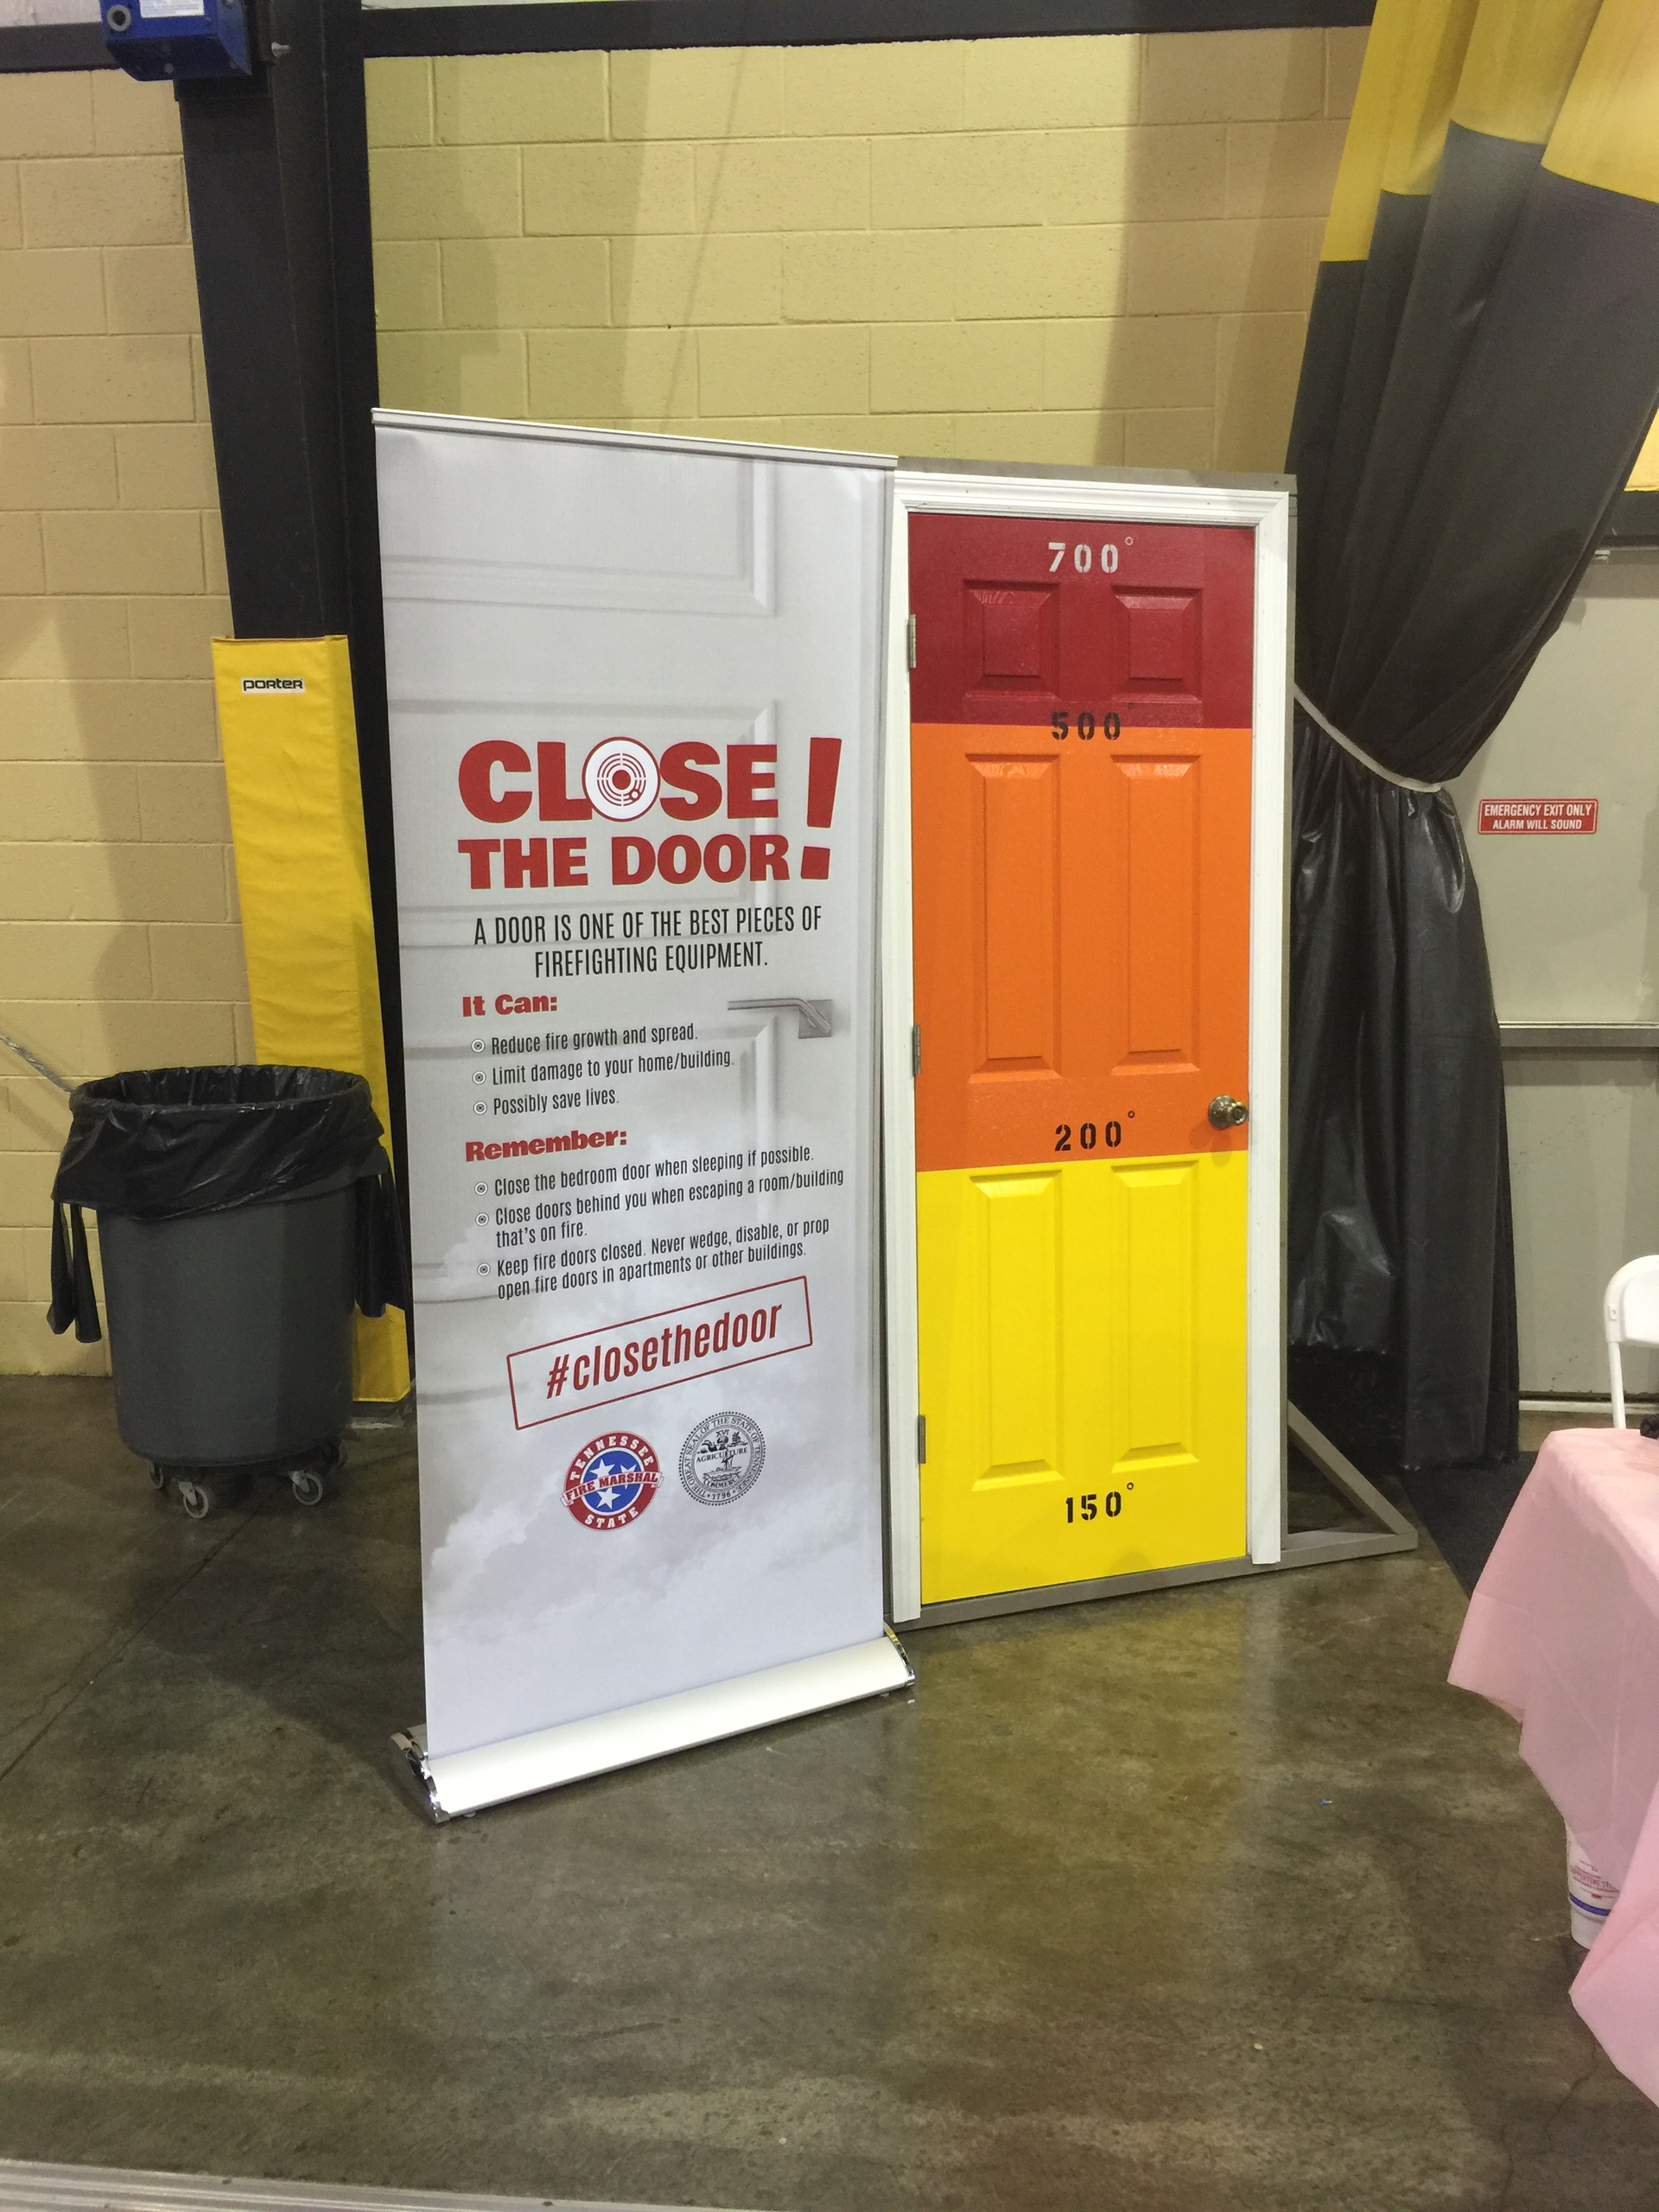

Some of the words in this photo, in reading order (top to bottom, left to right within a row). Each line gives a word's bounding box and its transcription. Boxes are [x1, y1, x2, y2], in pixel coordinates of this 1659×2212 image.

[458, 736, 779, 823] CLOSE
[1484, 804, 1541, 817] EMERGENCY
[1543, 804, 1564, 817] EXIT
[1566, 804, 1592, 817] ONLY
[1492, 819, 1524, 830] ALARM
[1526, 819, 1548, 830] WILL
[1550, 819, 1582, 830] SOUND
[457, 836, 588, 890] THE
[611, 833, 790, 887] DOOR
[474, 918, 486, 945] A
[495, 916, 545, 944] DOOR
[555, 914, 571, 942] IS
[580, 912, 614, 940] ONE
[623, 912, 644, 938] OF
[651, 910, 682, 937] THE
[690, 909, 729, 935] BEST
[737, 906, 794, 933] PIECES
[802, 906, 822, 931] OF
[535, 946, 657, 978] FIREFIGHTING
[665, 941, 767, 973] EQUIPMENT.
[462, 995, 486, 1017] It
[494, 994, 557, 1015] Can:
[492, 1036, 540, 1055] Reduce
[545, 1033, 568, 1051] fire
[573, 1028, 618, 1051] growth
[623, 1026, 646, 1045] and
[652, 1023, 697, 1045] spread.
[493, 1065, 526, 1085] Limit
[531, 1063, 582, 1082] damage
[587, 1059, 600, 1077] to
[605, 1058, 633, 1077] your
[638, 1050, 734, 1073] home/building.
[493, 1094, 548, 1116] Possibly
[552, 1092, 581, 1109] save
[586, 1088, 619, 1106] lives.
[466, 1129, 626, 1162] Remember:
[495, 1178, 530, 1197] Close
[534, 1173, 556, 1192] the
[561, 1167, 617, 1188] bedroom
[622, 1164, 651, 1181] door
[655, 1160, 687, 1177] when
[692, 1153, 743, 1173] sleeping
[748, 1150, 756, 1166] if
[761, 1146, 813, 1167] possible.
[496, 1207, 531, 1225] Close
[536, 1201, 571, 1220] doors
[576, 1193, 620, 1214] behind
[625, 1192, 646, 1211] you
[652, 1188, 684, 1205] when
[689, 1179, 742, 1201] escaping
[747, 1179, 754, 1193] a
[759, 1169, 844, 1193] room/building
[498, 1259, 528, 1277] Keep
[533, 1254, 556, 1271] fire
[561, 1249, 596, 1267] doors
[601, 1240, 645, 1262] closed.
[652, 1236, 685, 1255] Never
[690, 1230, 732, 1249] wedge,
[736, 1223, 782, 1244] disable,
[787, 1222, 799, 1236] or
[804, 1218, 829, 1237] prop
[541, 1226, 556, 1242] on
[561, 1221, 587, 1239] fire.
[498, 1281, 530, 1300] open
[535, 1275, 557, 1294] fire
[563, 1270, 598, 1289] doors
[603, 1267, 614, 1283] in
[620, 1256, 691, 1282] apartments
[696, 1255, 708, 1270] or
[712, 1249, 744, 1268] other
[748, 1243, 806, 1263] buildings.
[546, 1304, 783, 1400] #closethedoor
[569, 1435, 654, 1481] TENNESSEE
[696, 1447, 748, 1463] AGRICULTURE
[565, 1481, 595, 1502] FIRE
[599, 1472, 658, 1488] MARSHAL
[712, 1491, 731, 1500] 1796
[584, 1506, 639, 1529] STATE
